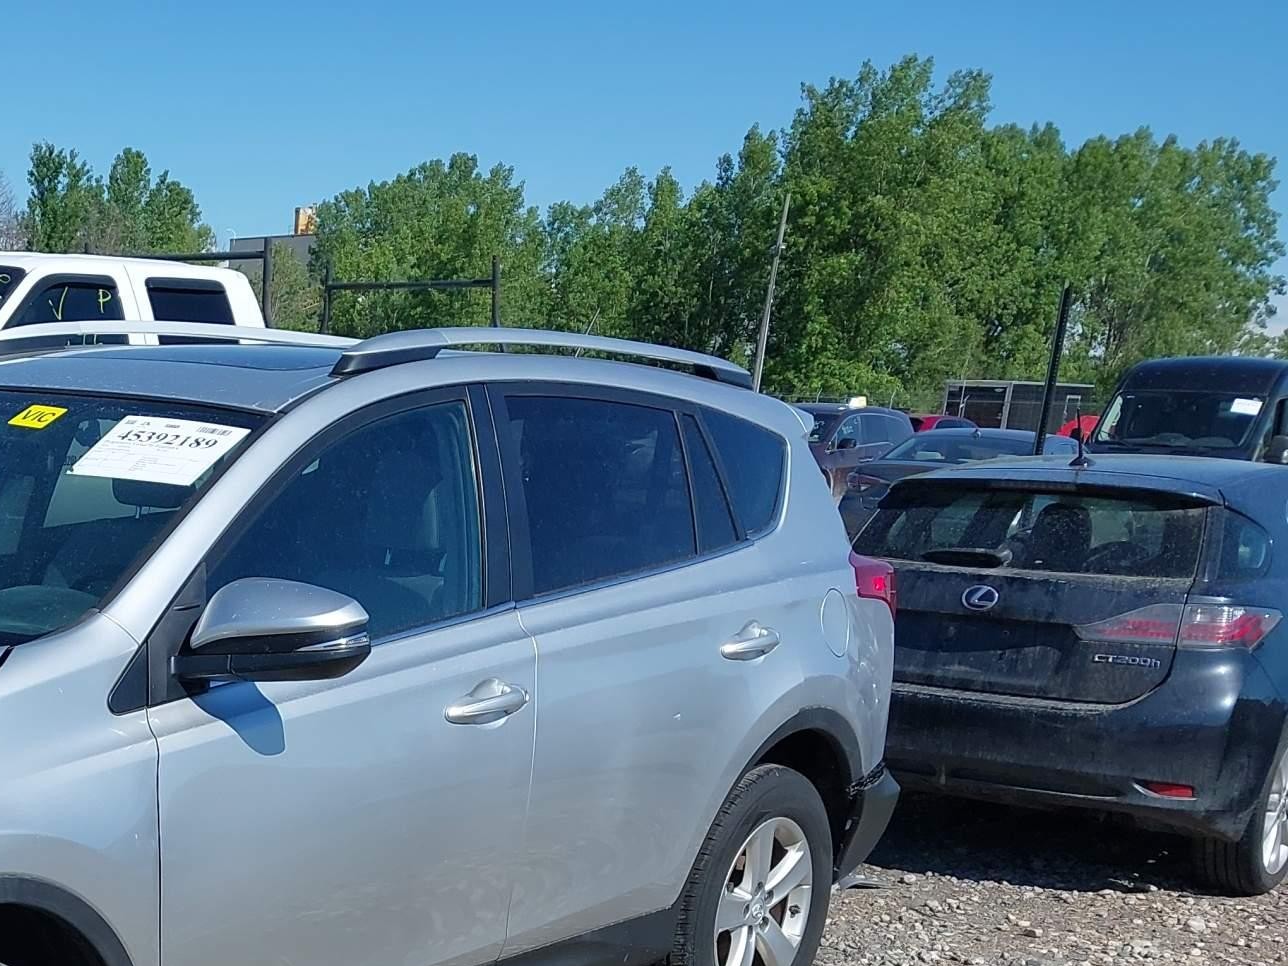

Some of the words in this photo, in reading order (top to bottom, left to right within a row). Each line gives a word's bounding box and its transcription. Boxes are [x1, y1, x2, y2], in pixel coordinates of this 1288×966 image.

[48, 286, 69, 320] V
[97, 288, 112, 314] P
[117, 429, 218, 449] 45392189
